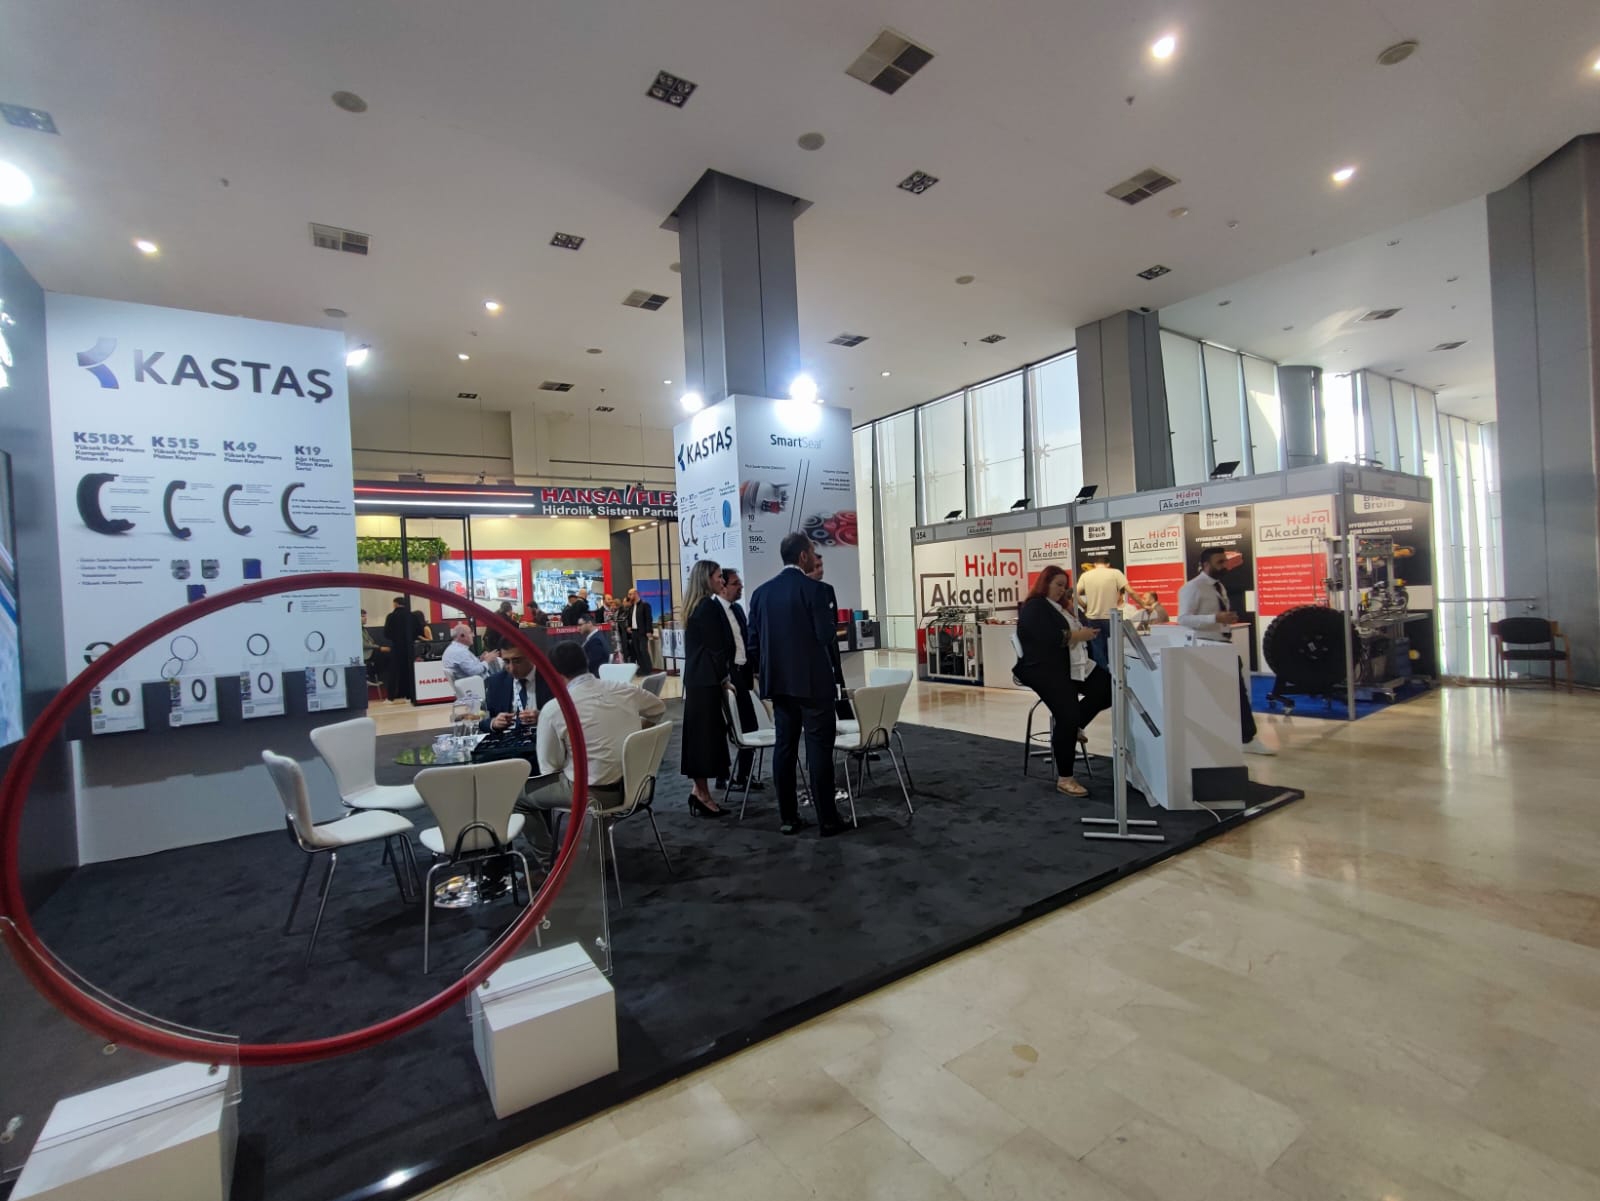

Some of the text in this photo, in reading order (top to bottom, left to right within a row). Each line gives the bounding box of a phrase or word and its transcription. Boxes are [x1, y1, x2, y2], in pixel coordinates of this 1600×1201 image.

[134, 349, 333, 403] KASTAŞ
[74, 431, 134, 445] K518X
[223, 441, 257, 452] K49
[295, 445, 321, 456] K19
[687, 426, 732, 465] KASTAŞ
[541, 487, 622, 504] HANSA
[1176, 489, 1200, 500] Hidro
[1163, 498, 1201, 510] Akademi
[1363, 501, 1395, 510] Bruin
[542, 505, 594, 516] Hidrolik
[597, 506, 639, 516] Sistem
[1286, 510, 1326, 526] Hidro
[1148, 528, 1178, 540] Hidro
[1264, 523, 1326, 540] Akademi
[1044, 540, 1067, 549] Hidro
[1132, 538, 1178, 550] Akademi
[1032, 549, 1068, 558] Akademi
[964, 551, 1018, 578] Hidro
[930, 579, 1019, 607] Akademi
